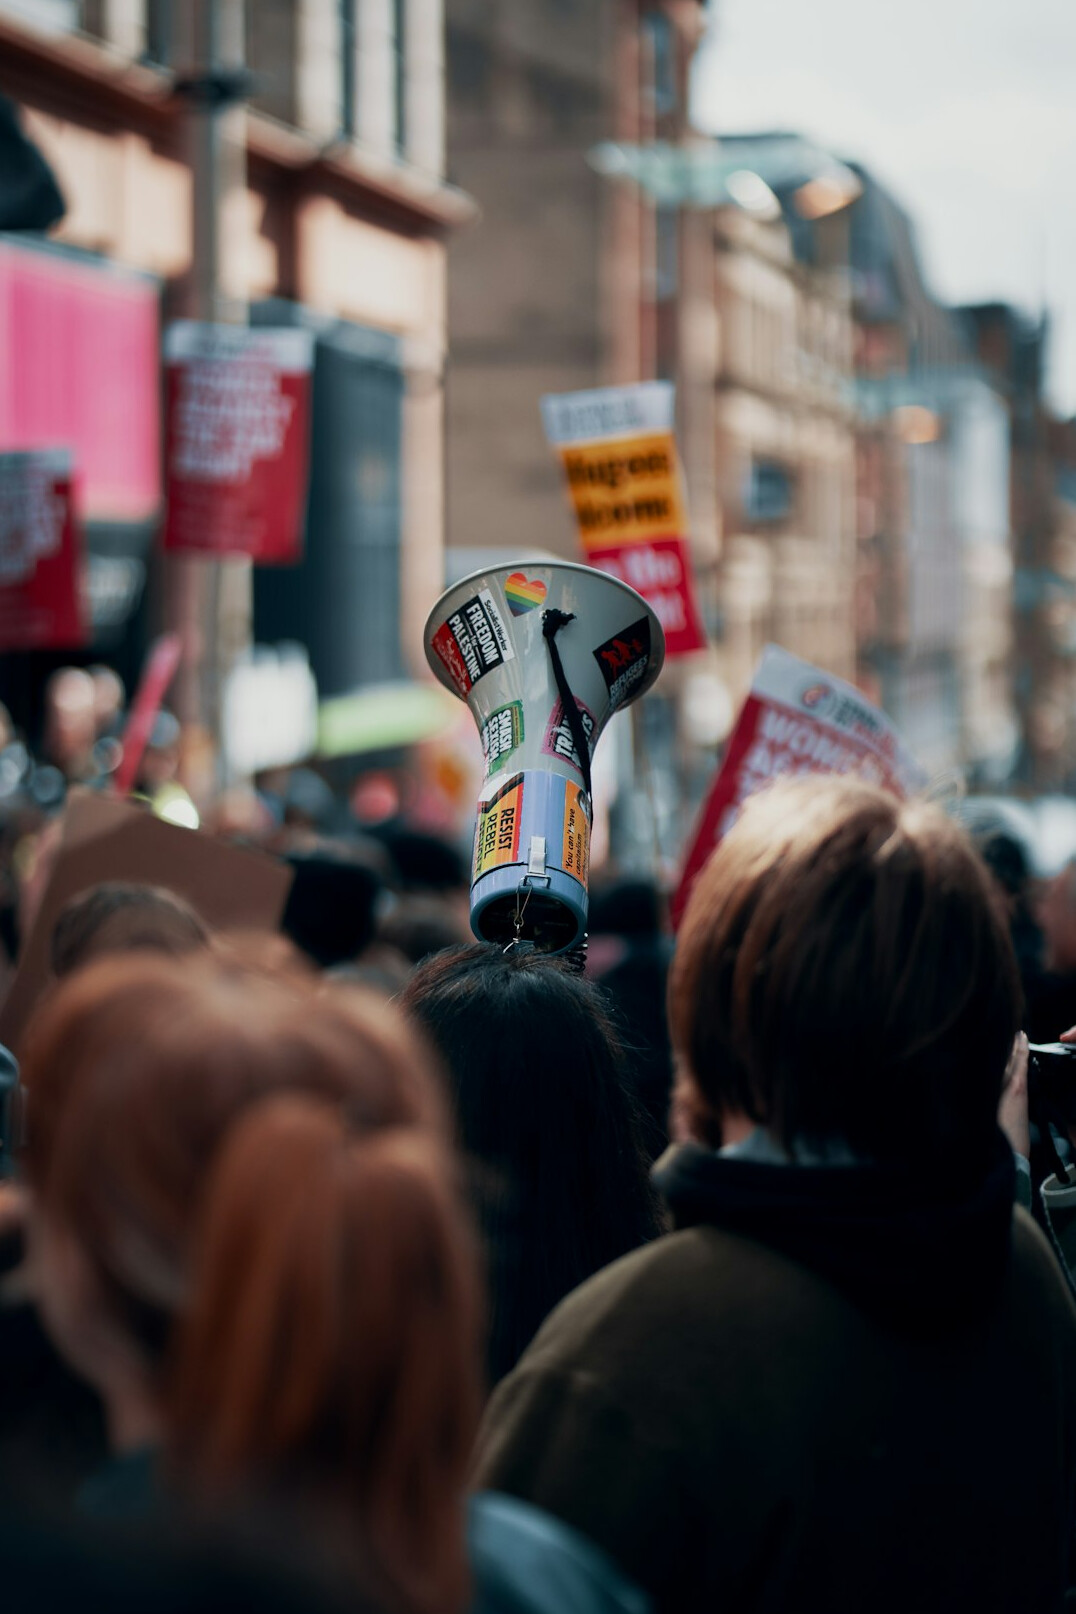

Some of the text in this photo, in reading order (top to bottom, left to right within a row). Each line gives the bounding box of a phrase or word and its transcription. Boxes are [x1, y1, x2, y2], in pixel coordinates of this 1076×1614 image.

[466, 603, 499, 665] FREEDOM
[470, 635, 478, 647] for
[485, 600, 508, 651] Socialist Worker
[449, 614, 481, 682] PALESTINE
[609, 654, 648, 696] REFUGEES
[488, 716, 499, 762] SEXISM
[498, 709, 512, 753] SMASH
[555, 715, 574, 758] TRA
[484, 813, 498, 860] REBEL
[499, 807, 515, 850] RESIST
[567, 808, 576, 828] have
